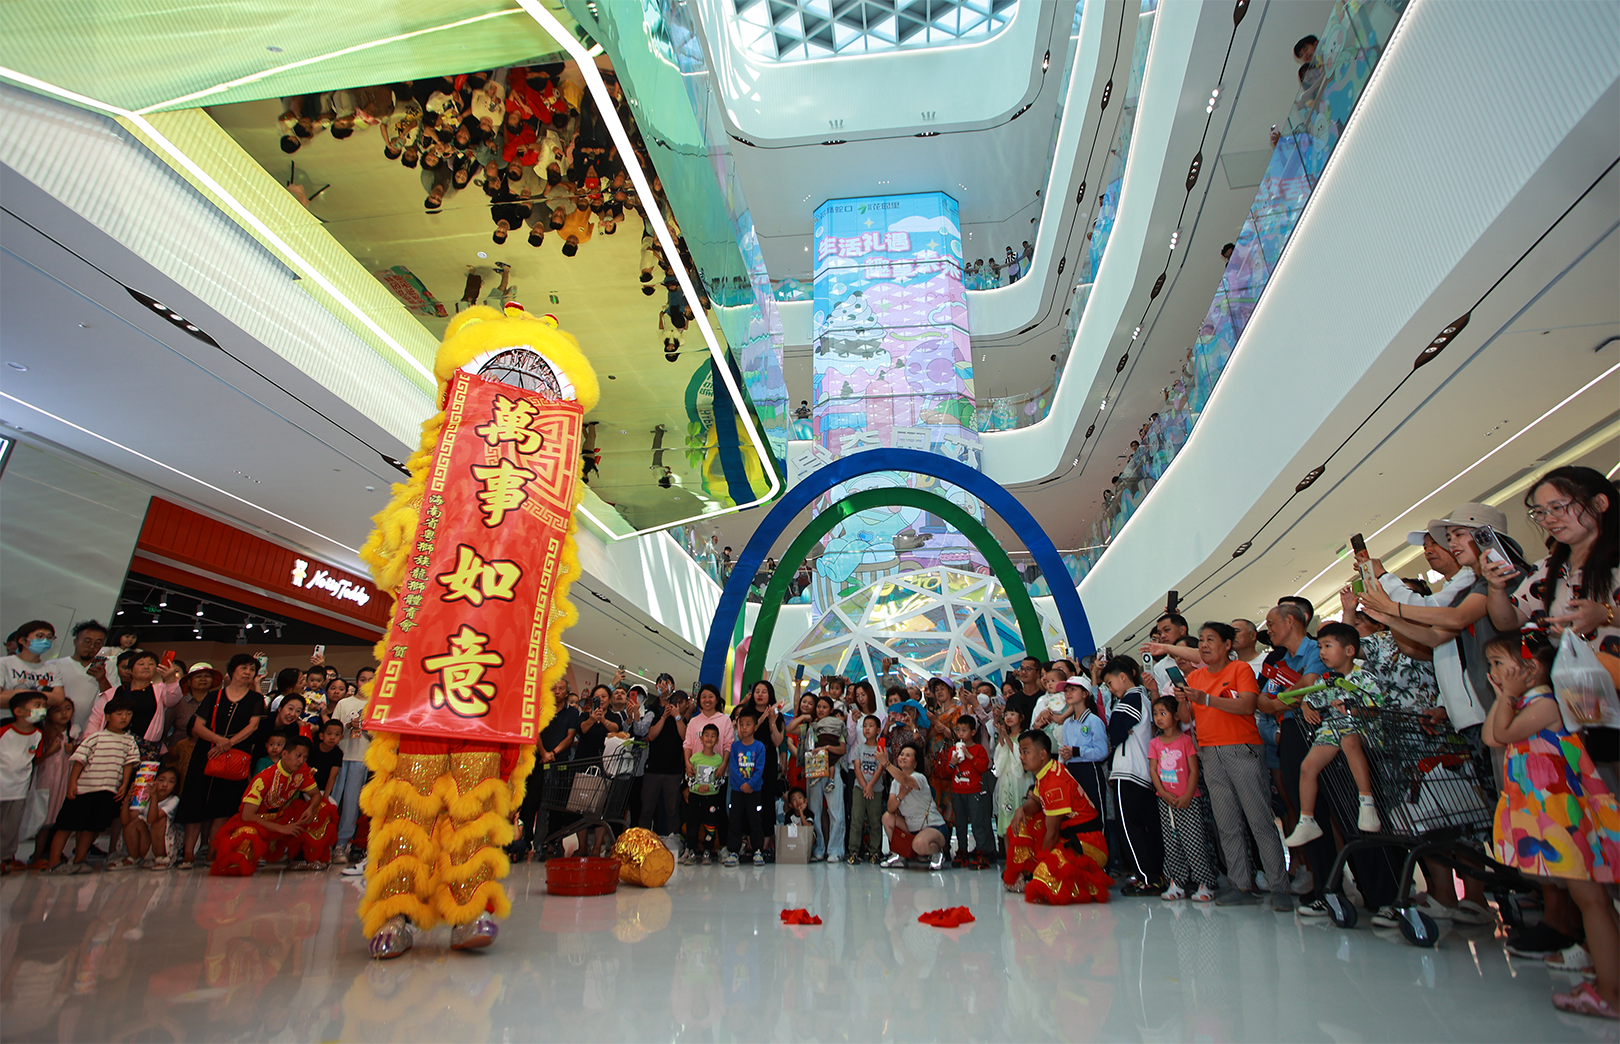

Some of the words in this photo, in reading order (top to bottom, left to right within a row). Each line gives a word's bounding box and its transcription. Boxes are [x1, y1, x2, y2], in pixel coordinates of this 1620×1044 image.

[818, 231, 911, 262] 生活礼遇
[864, 250, 962, 280] 趣享未来
[420, 393, 544, 719] 萬事如意
[11, 668, 53, 681] Mardi
